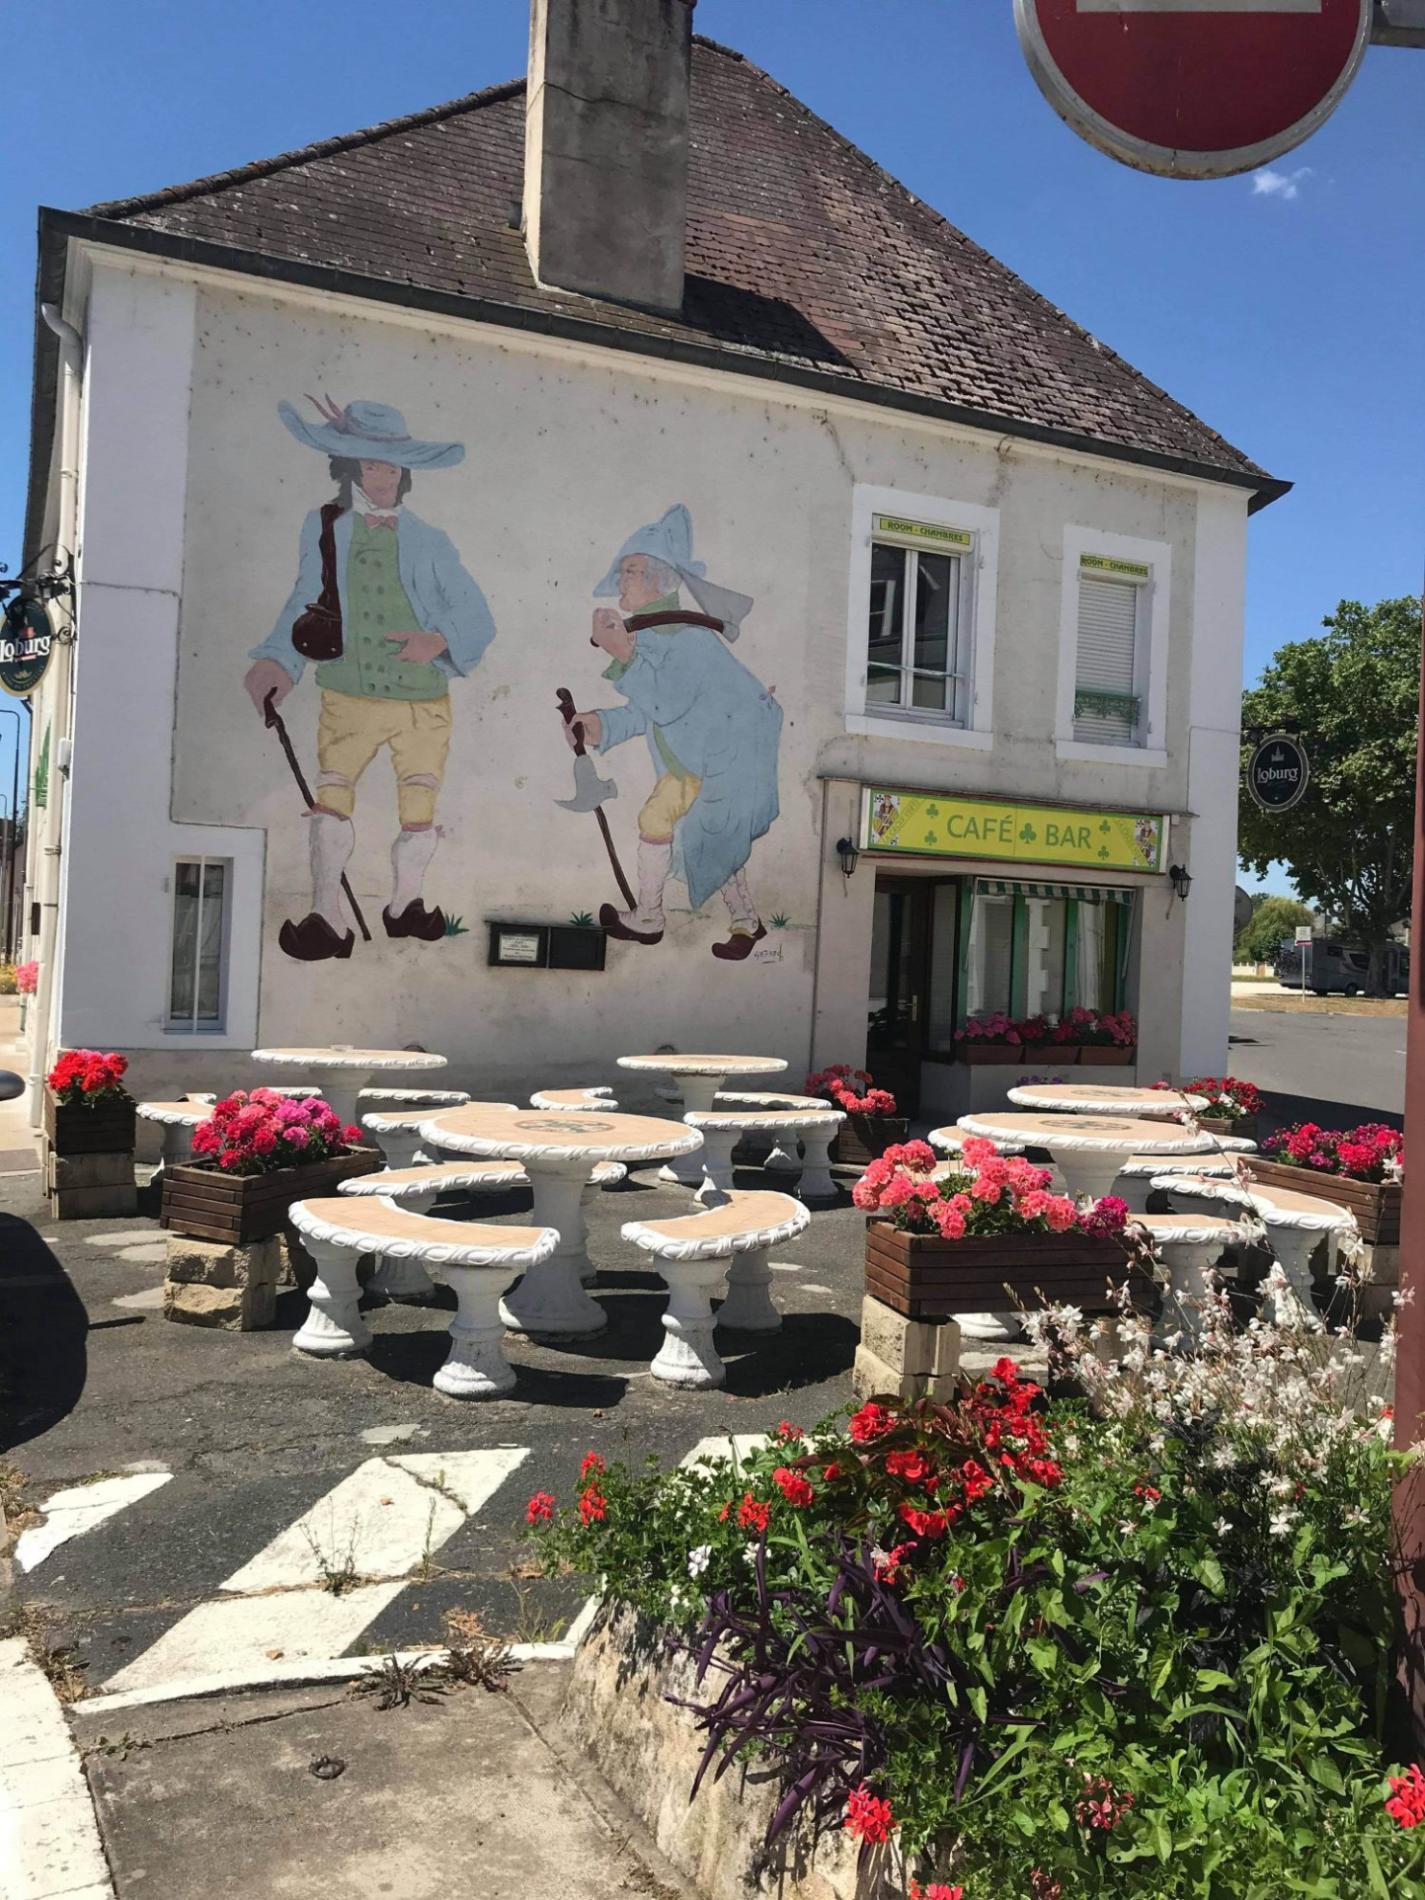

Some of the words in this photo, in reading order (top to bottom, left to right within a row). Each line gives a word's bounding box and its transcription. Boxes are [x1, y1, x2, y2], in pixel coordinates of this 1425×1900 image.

[887, 521, 913, 532] ROOM
[920, 527, 963, 542] CHAMBRES
[947, 814, 1013, 842] CAFÉ
[1045, 824, 1092, 849] BAR
